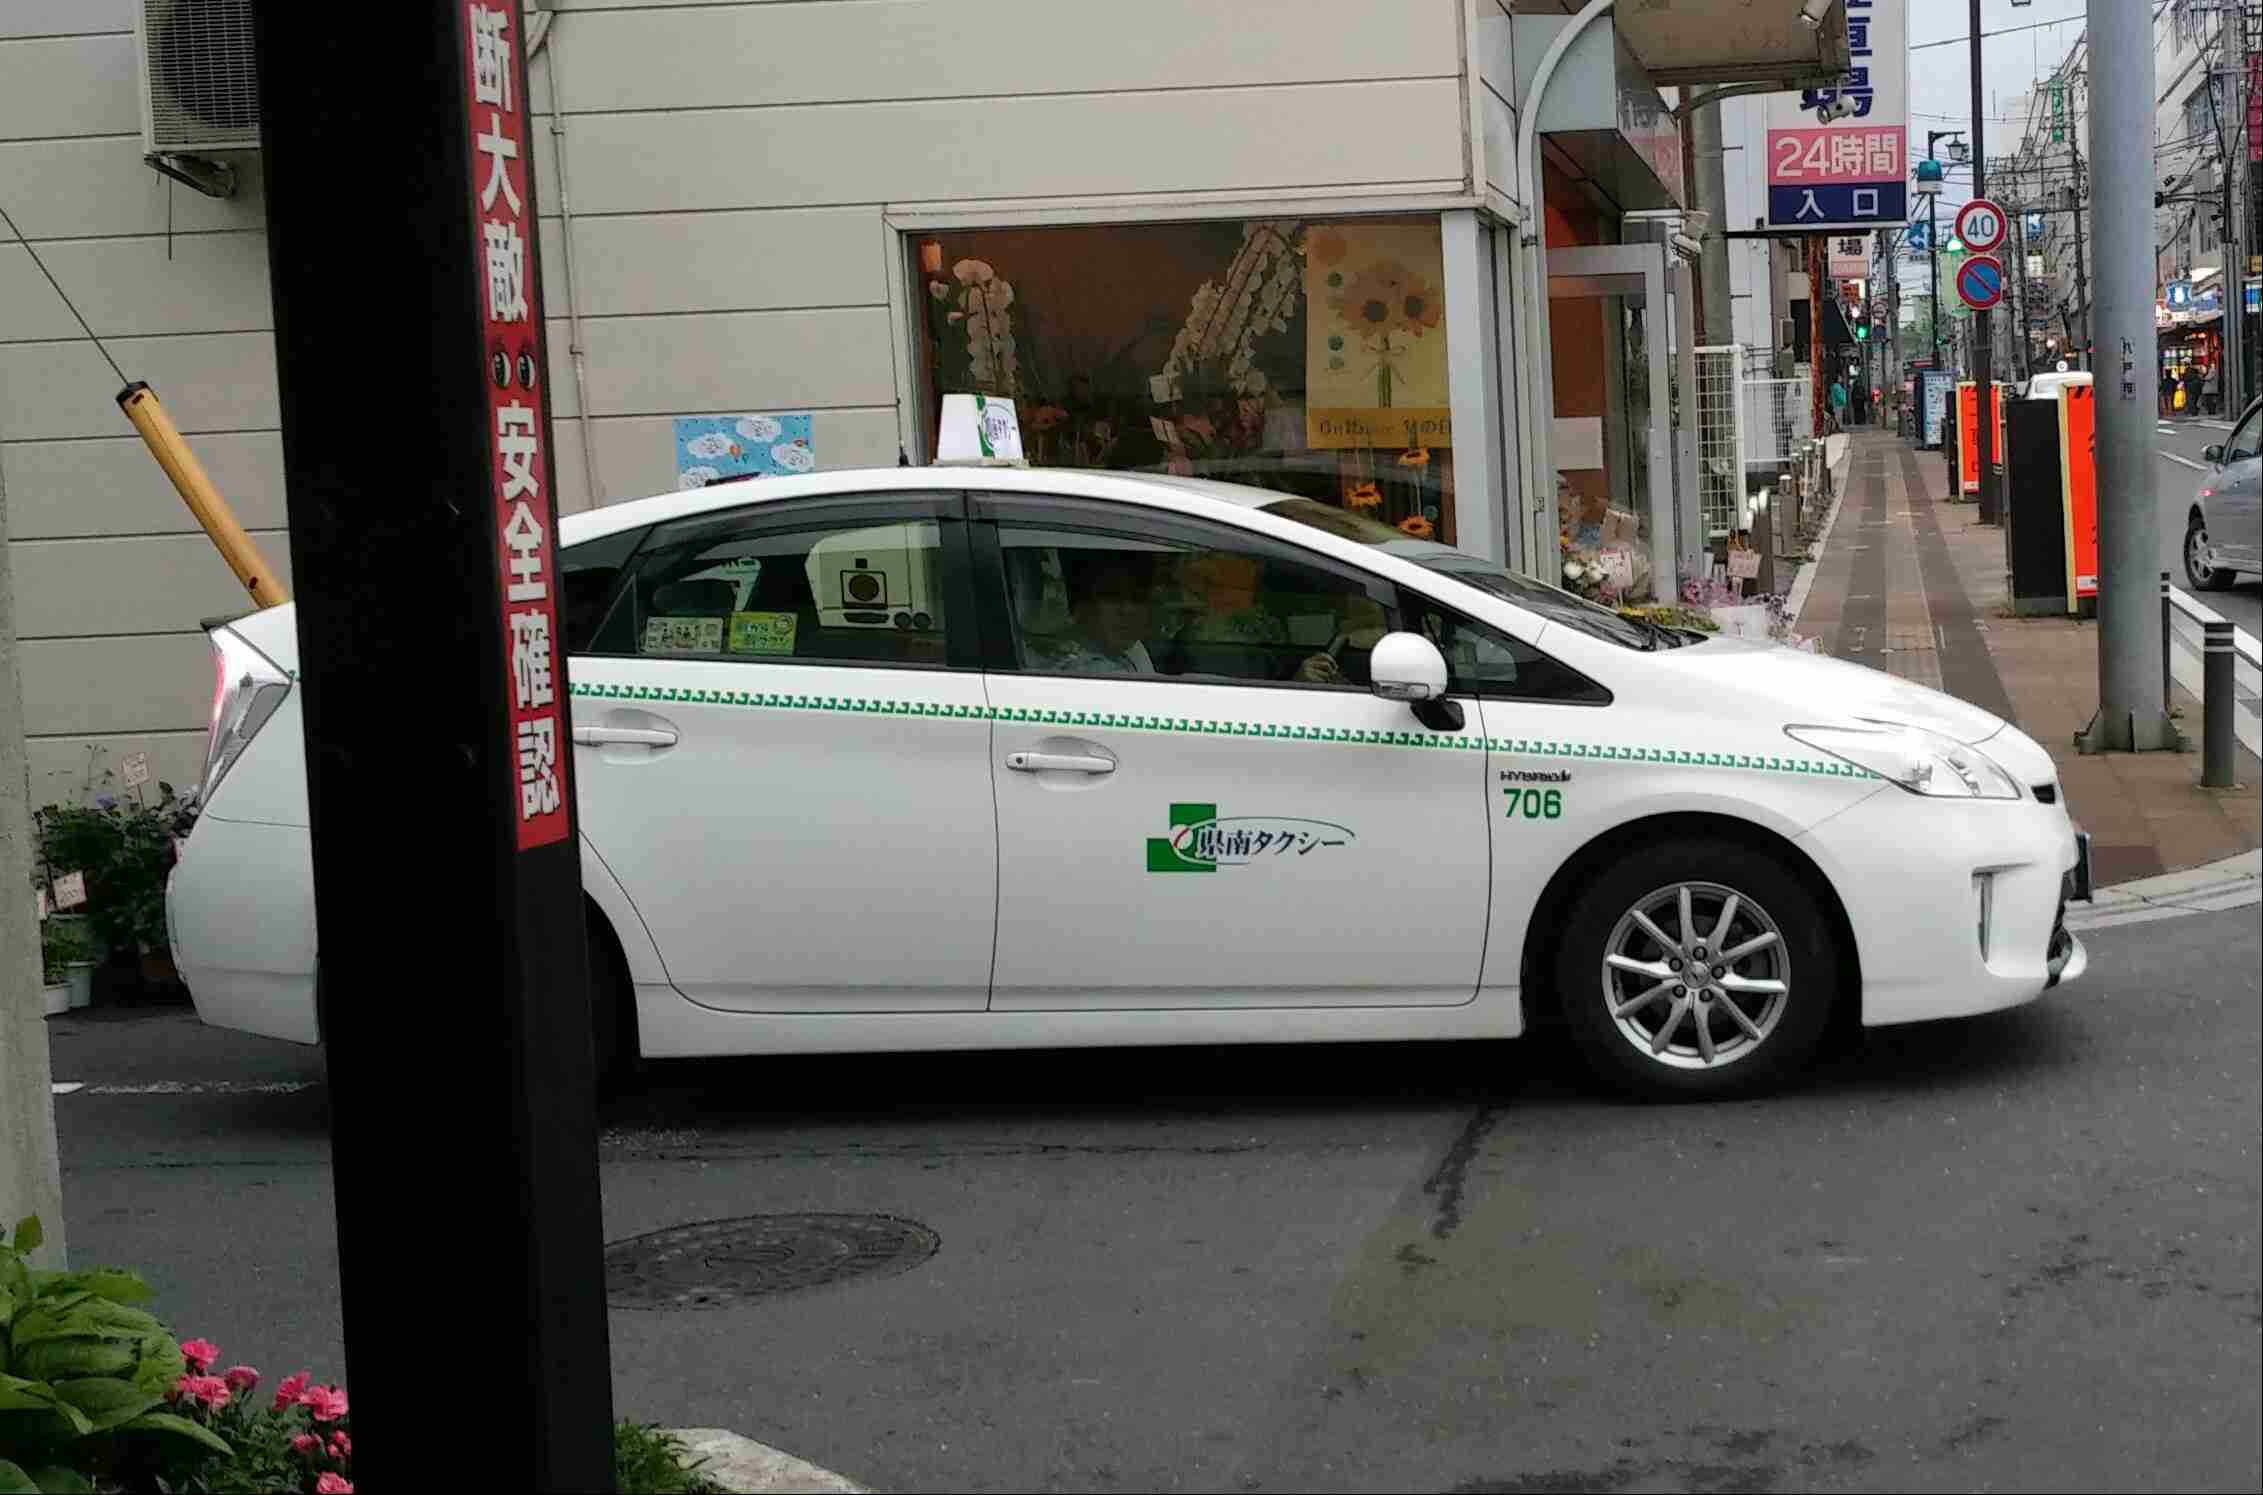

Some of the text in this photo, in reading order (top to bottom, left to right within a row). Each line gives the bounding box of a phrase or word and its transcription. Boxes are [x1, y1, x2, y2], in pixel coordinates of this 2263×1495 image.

[469, 3, 529, 322] 断大敵
[1775, 133, 1899, 177] 24時間
[1795, 189, 1879, 219] 入口
[1967, 214, 1995, 239] 40
[496, 399, 560, 820] 安全確認
[1503, 788, 1562, 819] 706
[1198, 827, 1346, 857] 県南タクシー
